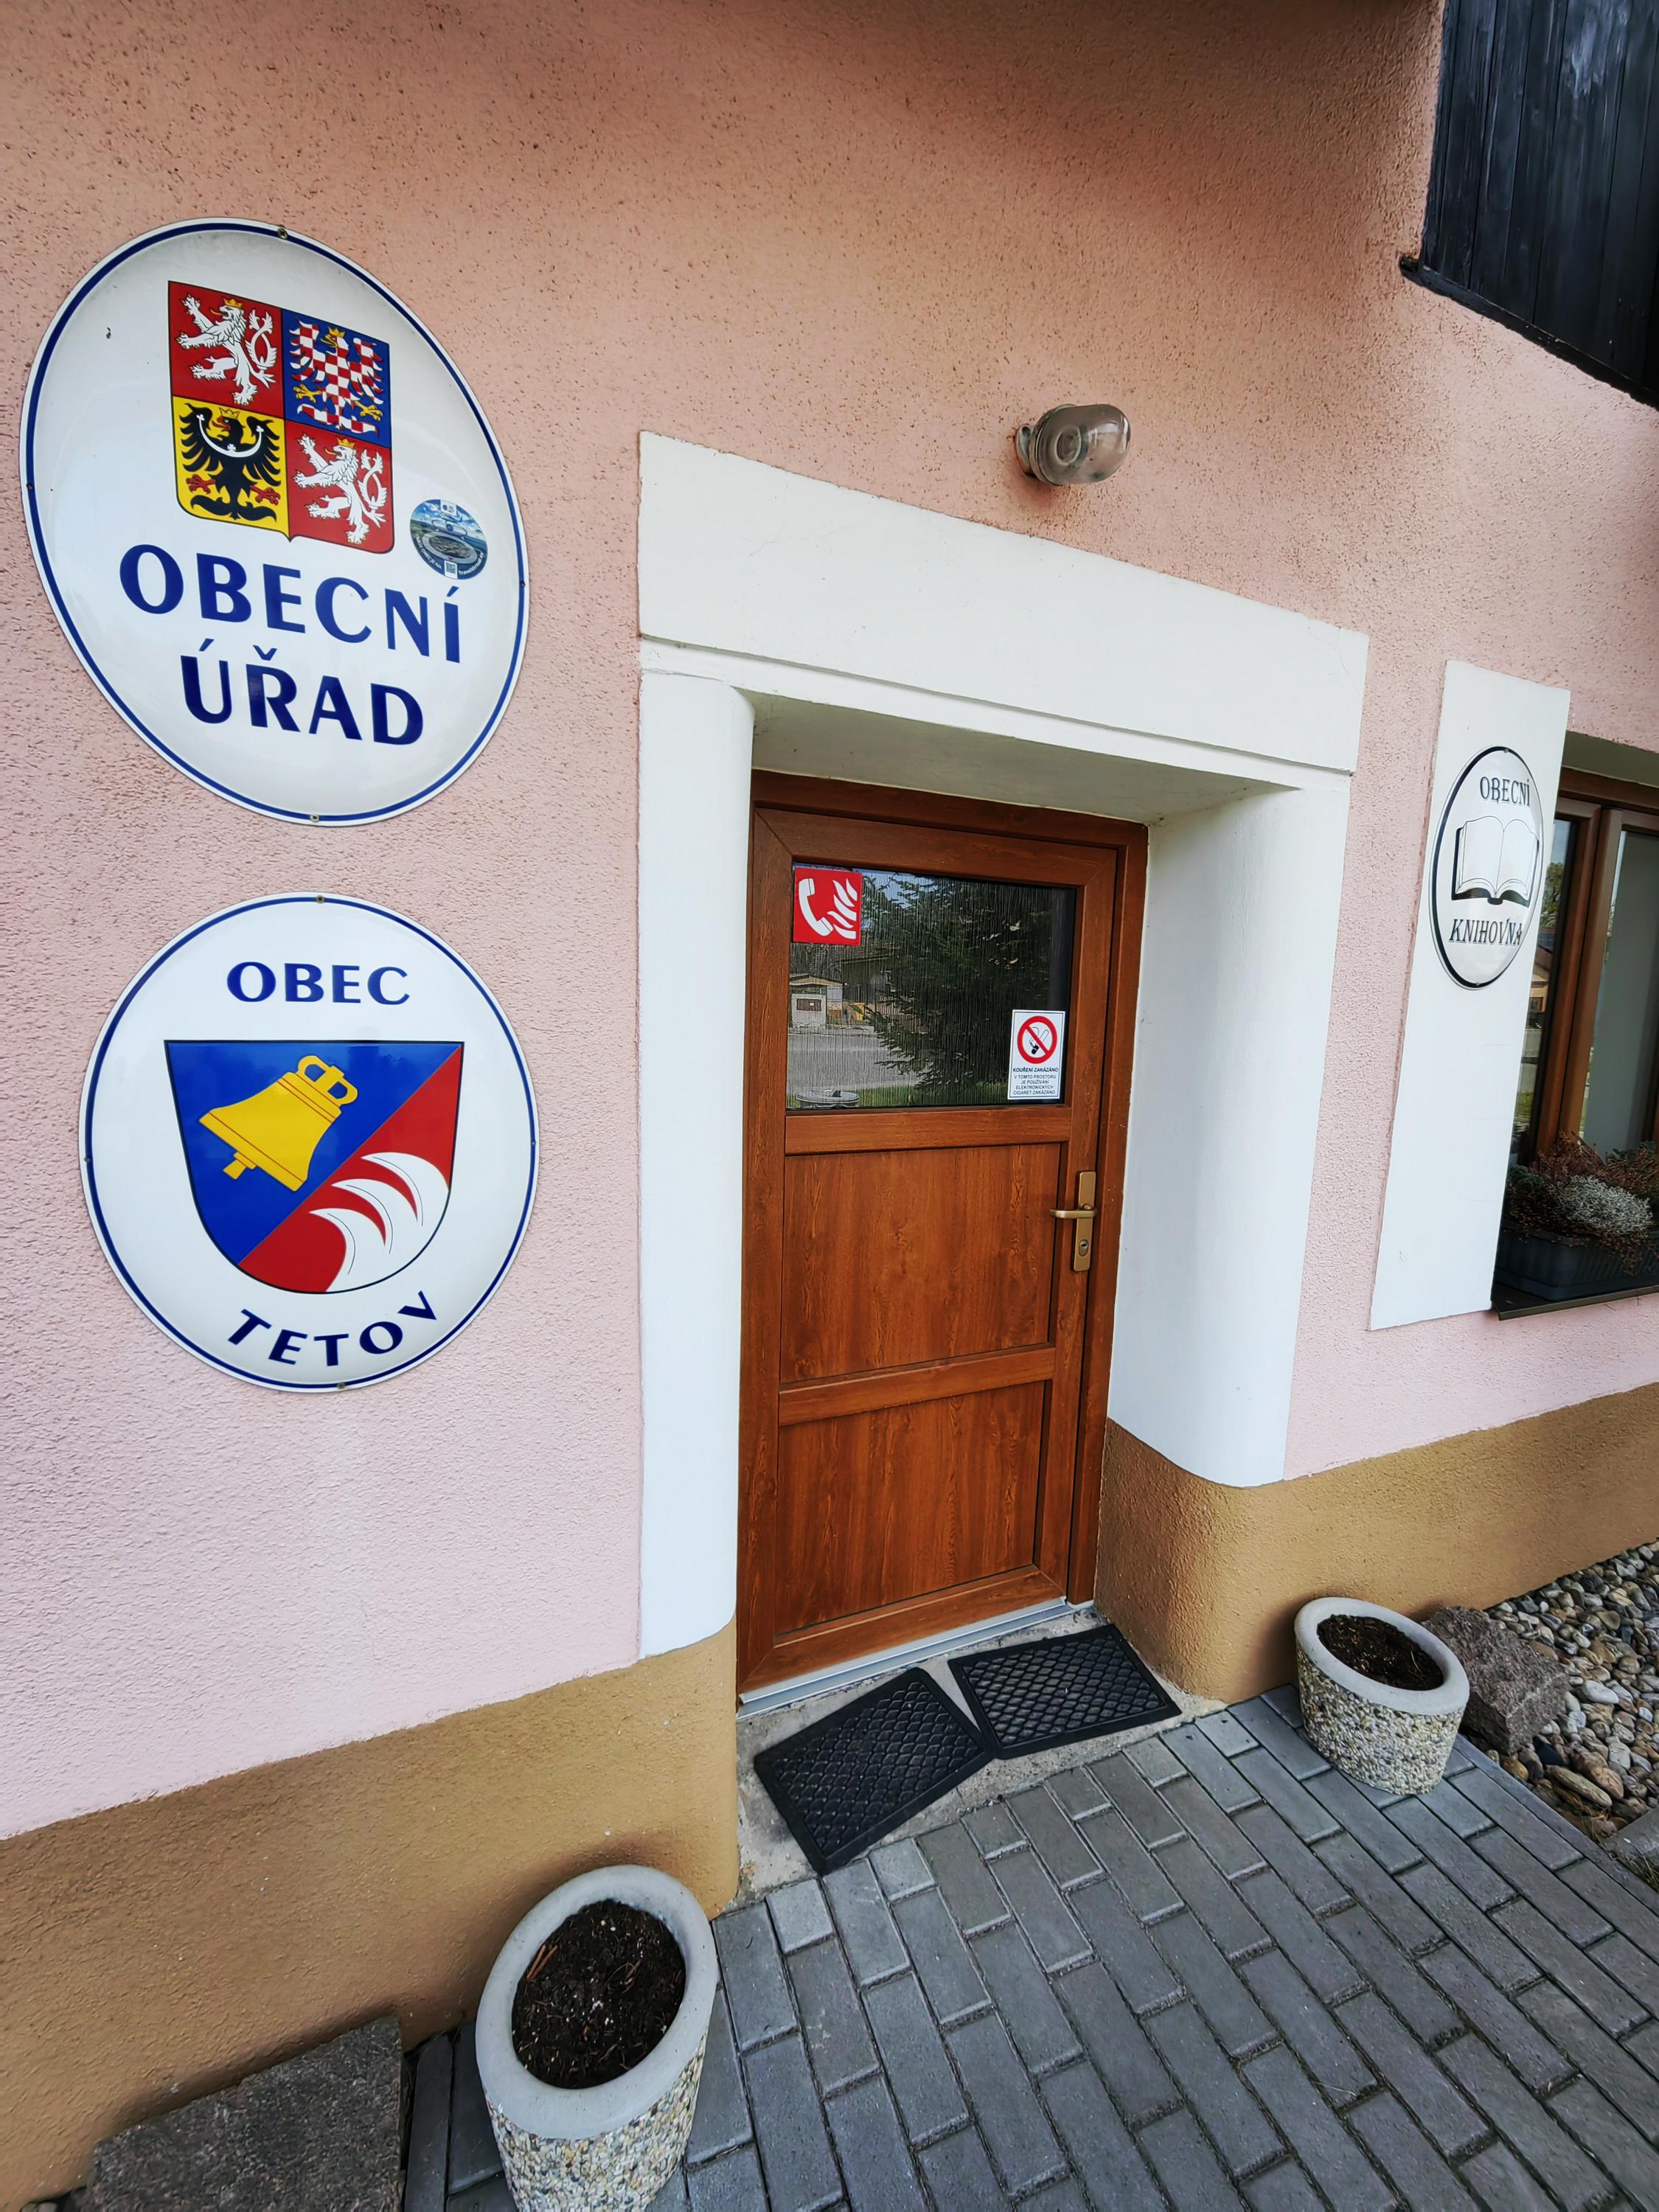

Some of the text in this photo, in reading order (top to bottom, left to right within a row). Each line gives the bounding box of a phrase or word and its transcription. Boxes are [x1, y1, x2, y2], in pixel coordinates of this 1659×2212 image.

[119, 543, 461, 664] OBECNÍ
[180, 639, 425, 746] ÚŘAD
[1479, 776, 1531, 807] OBECNÍ
[1448, 917, 1523, 947] KNIHOVNA
[226, 961, 410, 1006] OBEC
[227, 1290, 438, 1367] TETOV
